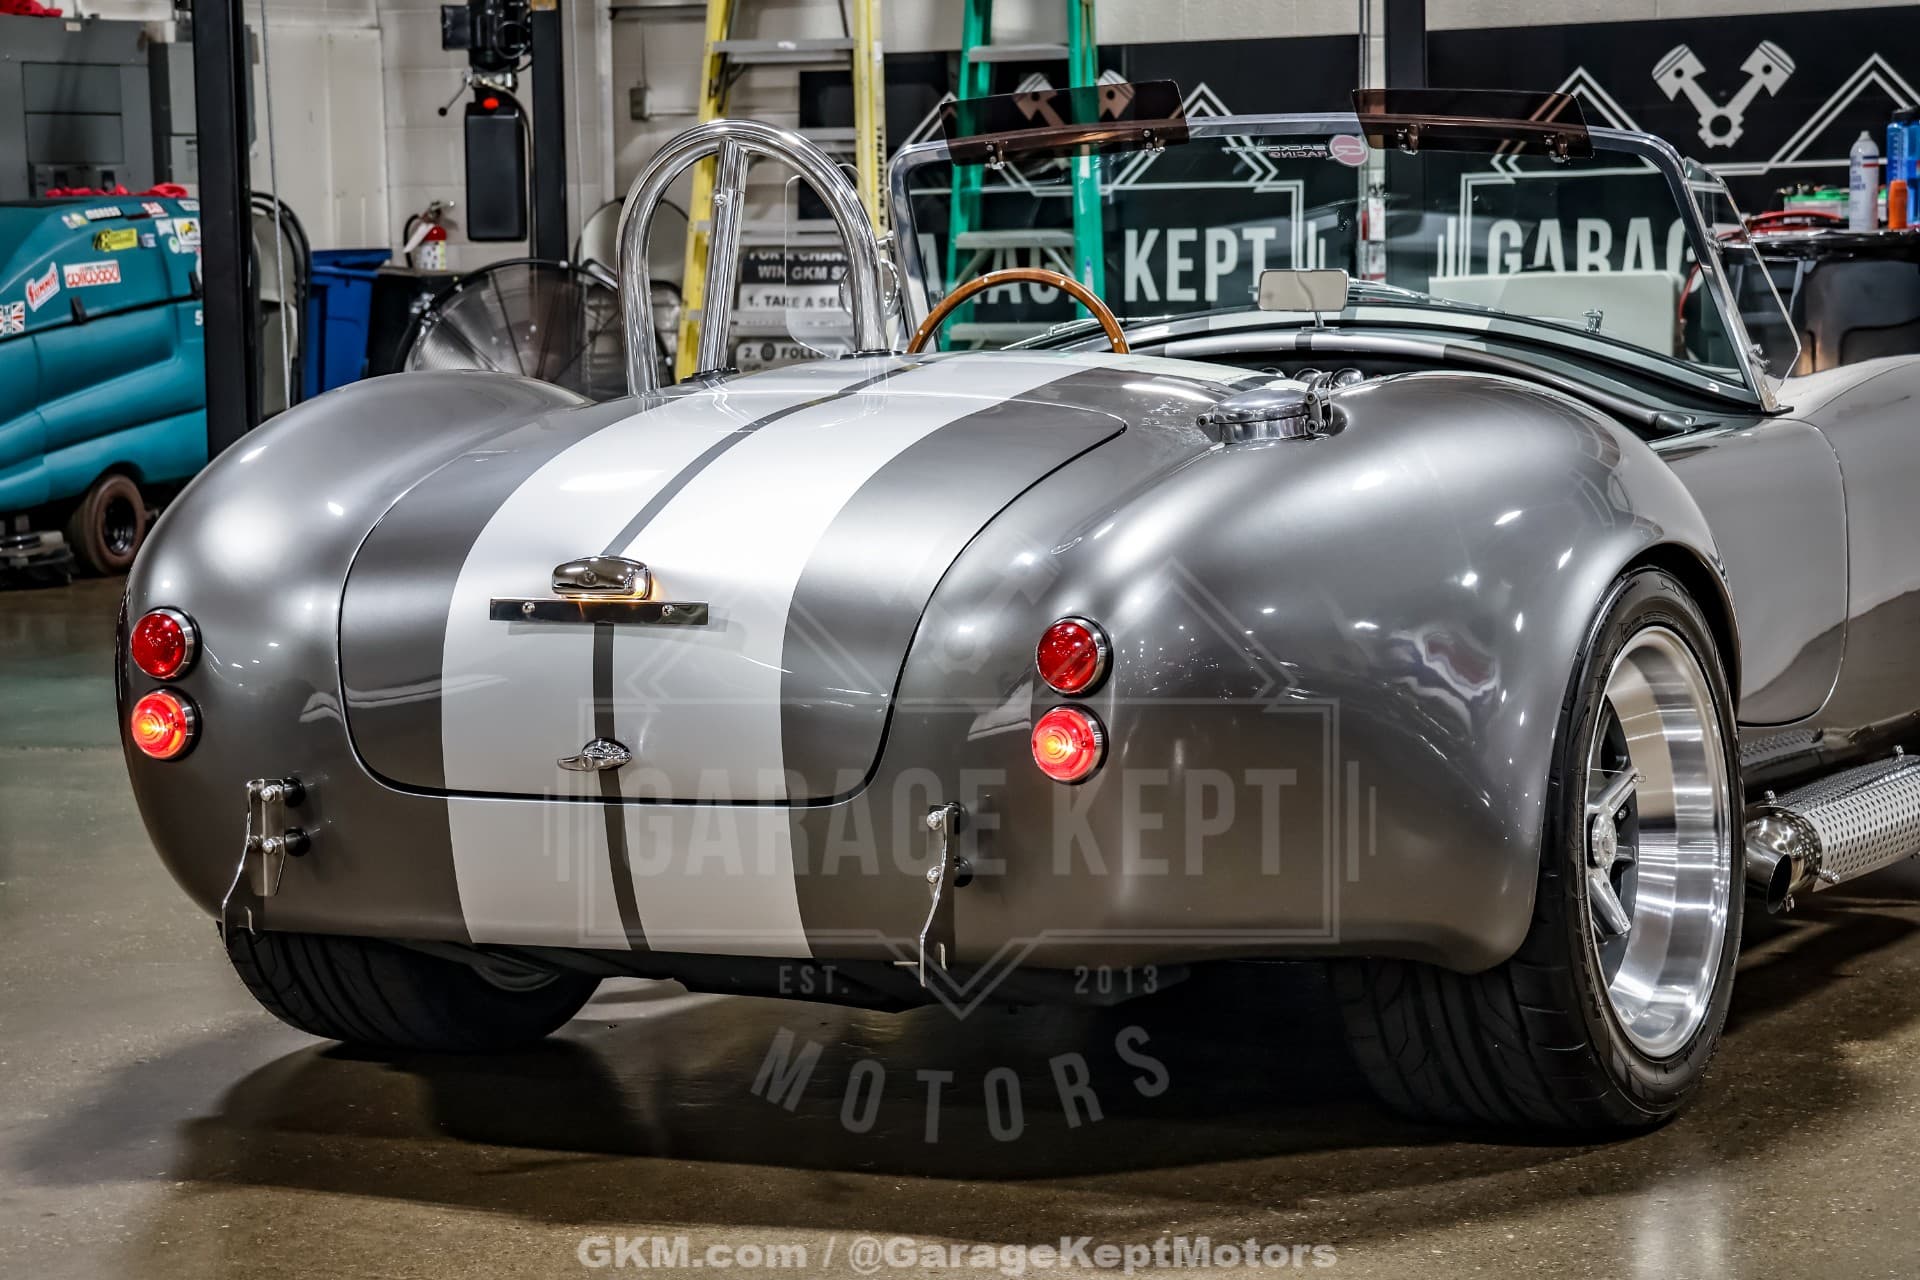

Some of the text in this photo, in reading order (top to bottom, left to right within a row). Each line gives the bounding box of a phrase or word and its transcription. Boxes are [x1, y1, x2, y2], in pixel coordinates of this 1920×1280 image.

[1124, 227, 1277, 302] KEPT
[791, 265, 828, 281] GKM
[804, 296, 814, 308] A
